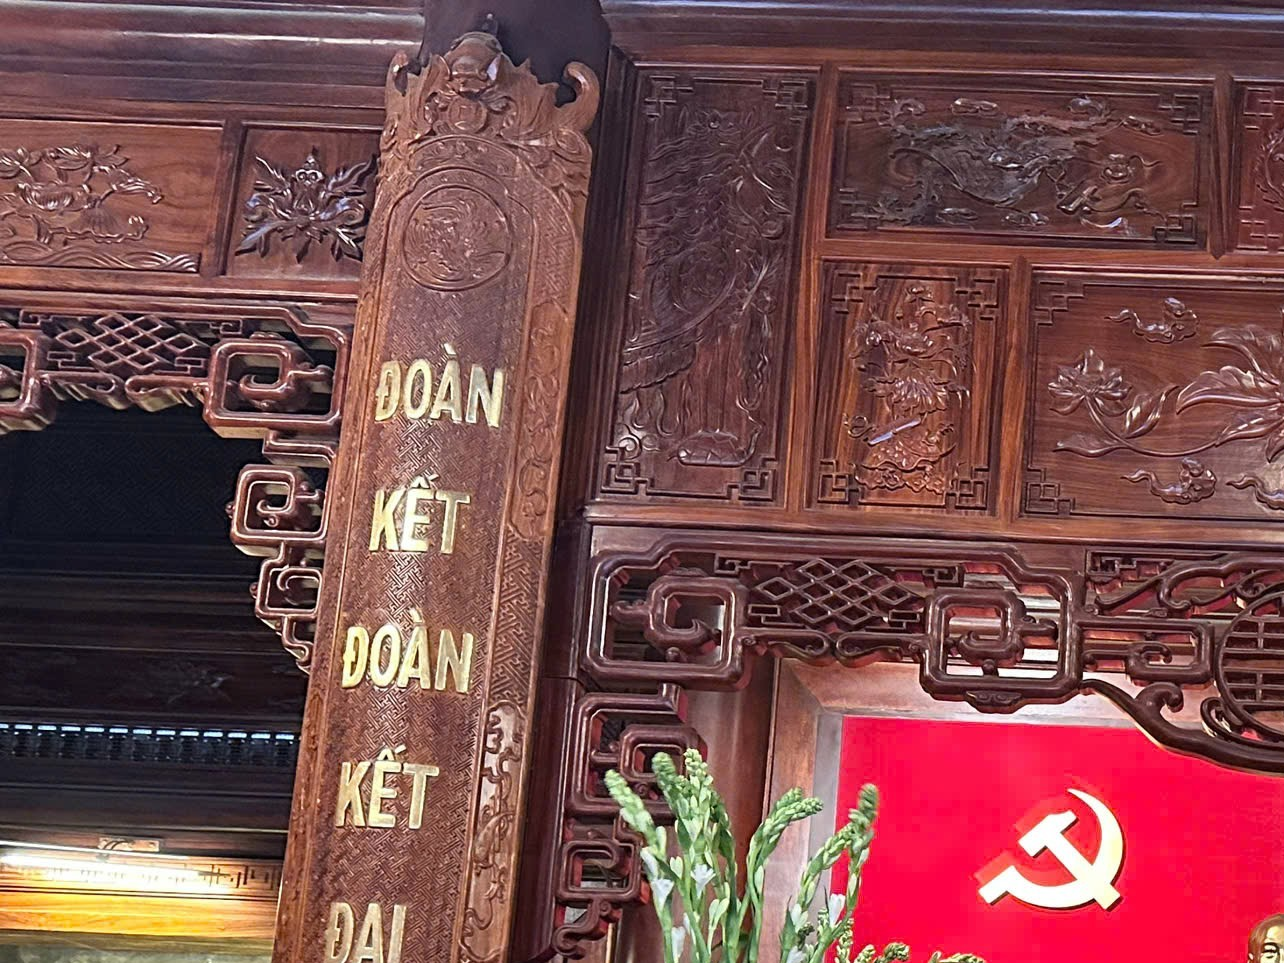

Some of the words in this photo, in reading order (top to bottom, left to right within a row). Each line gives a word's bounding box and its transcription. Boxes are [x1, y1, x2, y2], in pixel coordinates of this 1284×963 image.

[375, 343, 505, 429] ĐOÀN
[368, 474, 471, 556] KẾT
[341, 607, 475, 694] ĐOÀN
[335, 746, 439, 831] KẾT
